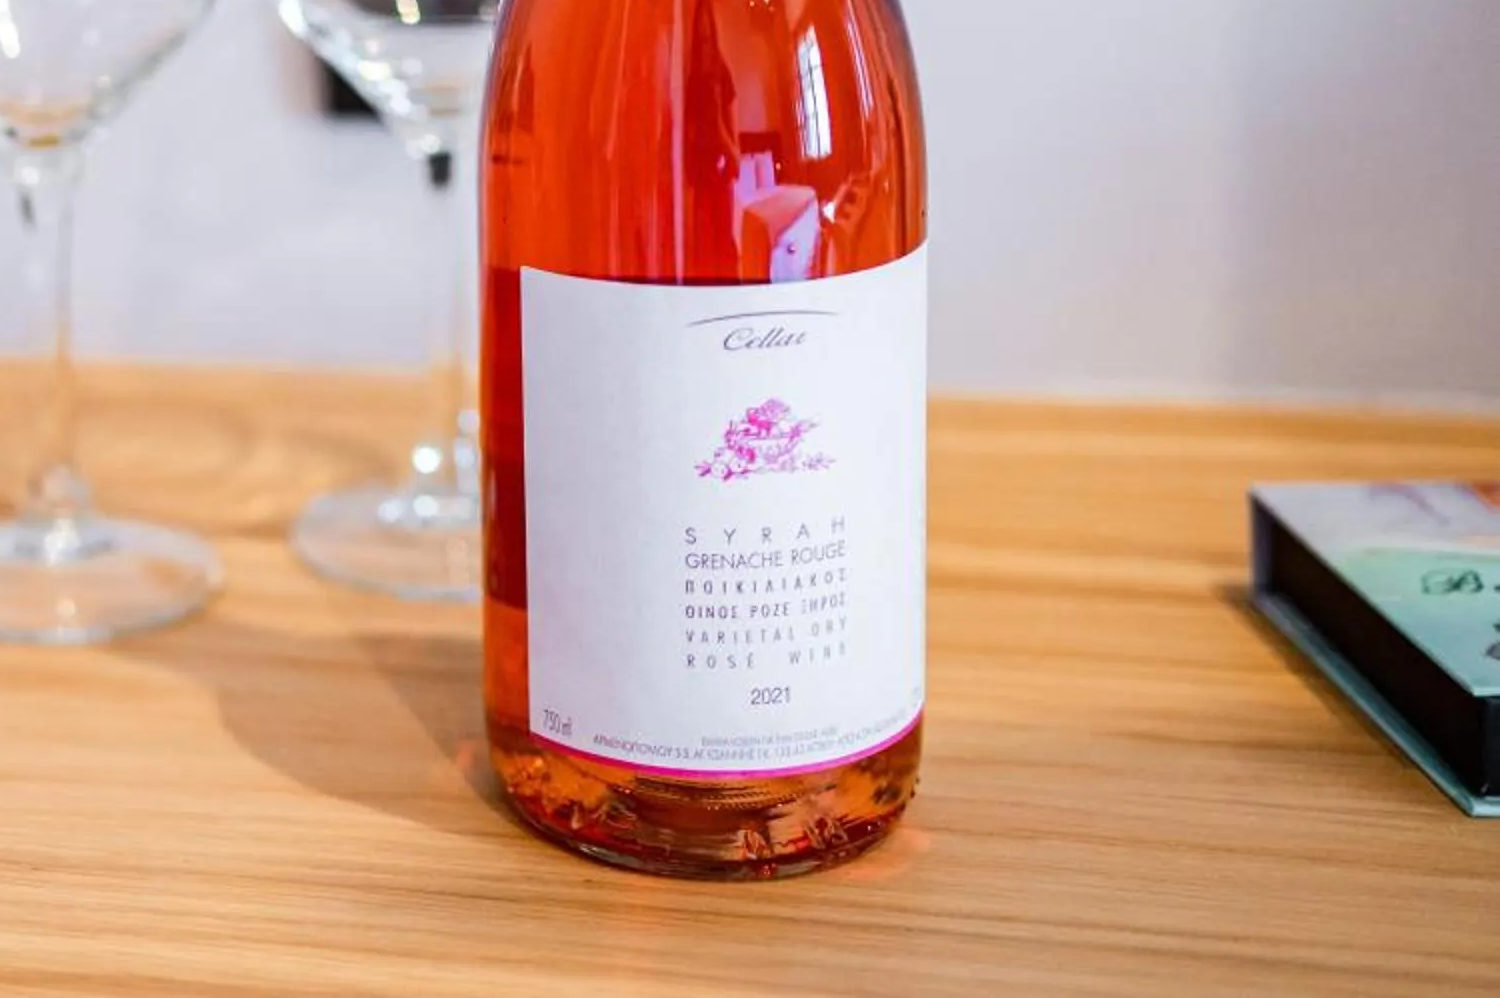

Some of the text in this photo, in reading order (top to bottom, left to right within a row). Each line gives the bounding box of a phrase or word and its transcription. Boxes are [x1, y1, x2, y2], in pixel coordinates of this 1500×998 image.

[684, 516, 845, 545] SYRAH
[684, 540, 846, 570] GRENACHE ROUGE
[750, 687, 791, 705] 2021
